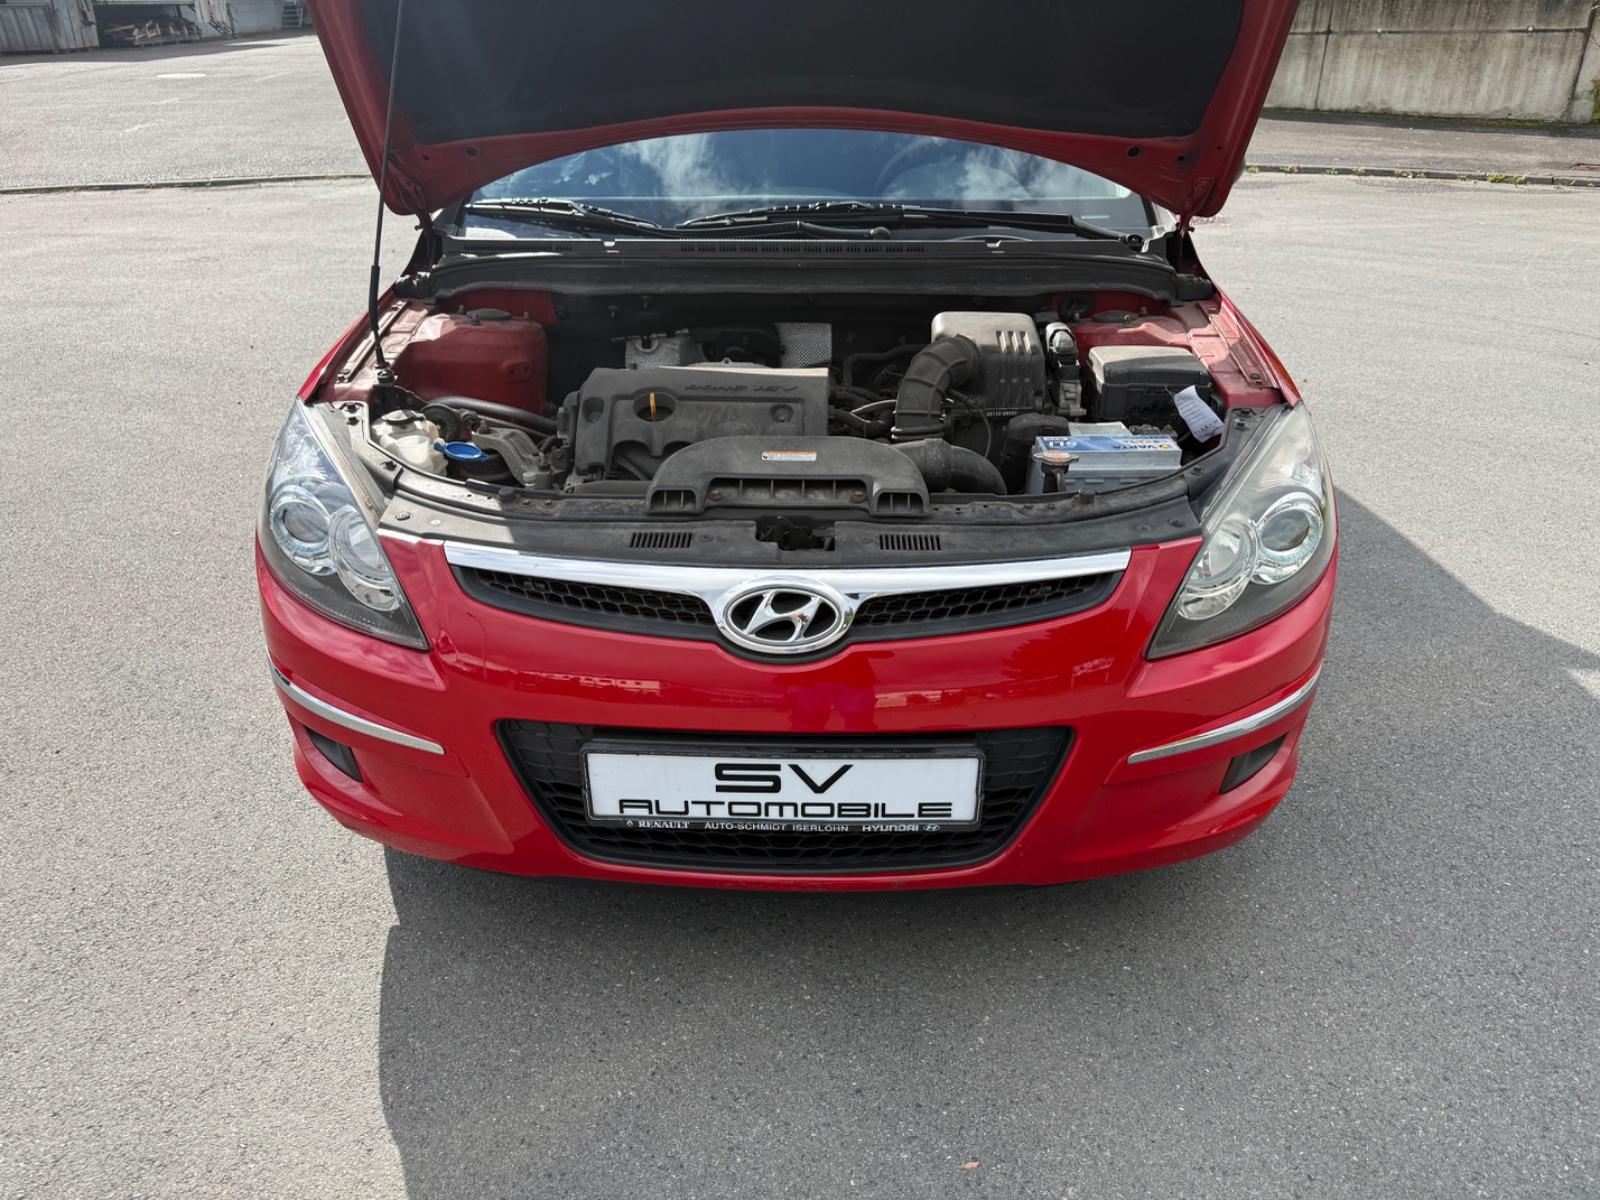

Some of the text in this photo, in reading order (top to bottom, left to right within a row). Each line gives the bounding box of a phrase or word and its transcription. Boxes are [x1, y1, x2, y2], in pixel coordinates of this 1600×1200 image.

[715, 763, 854, 794] SV
[619, 799, 953, 818] AUTOMOBILE
[638, 820, 919, 832] RENAULT AUTO-SCHMIDT ISERLOHN HYUNDAI
